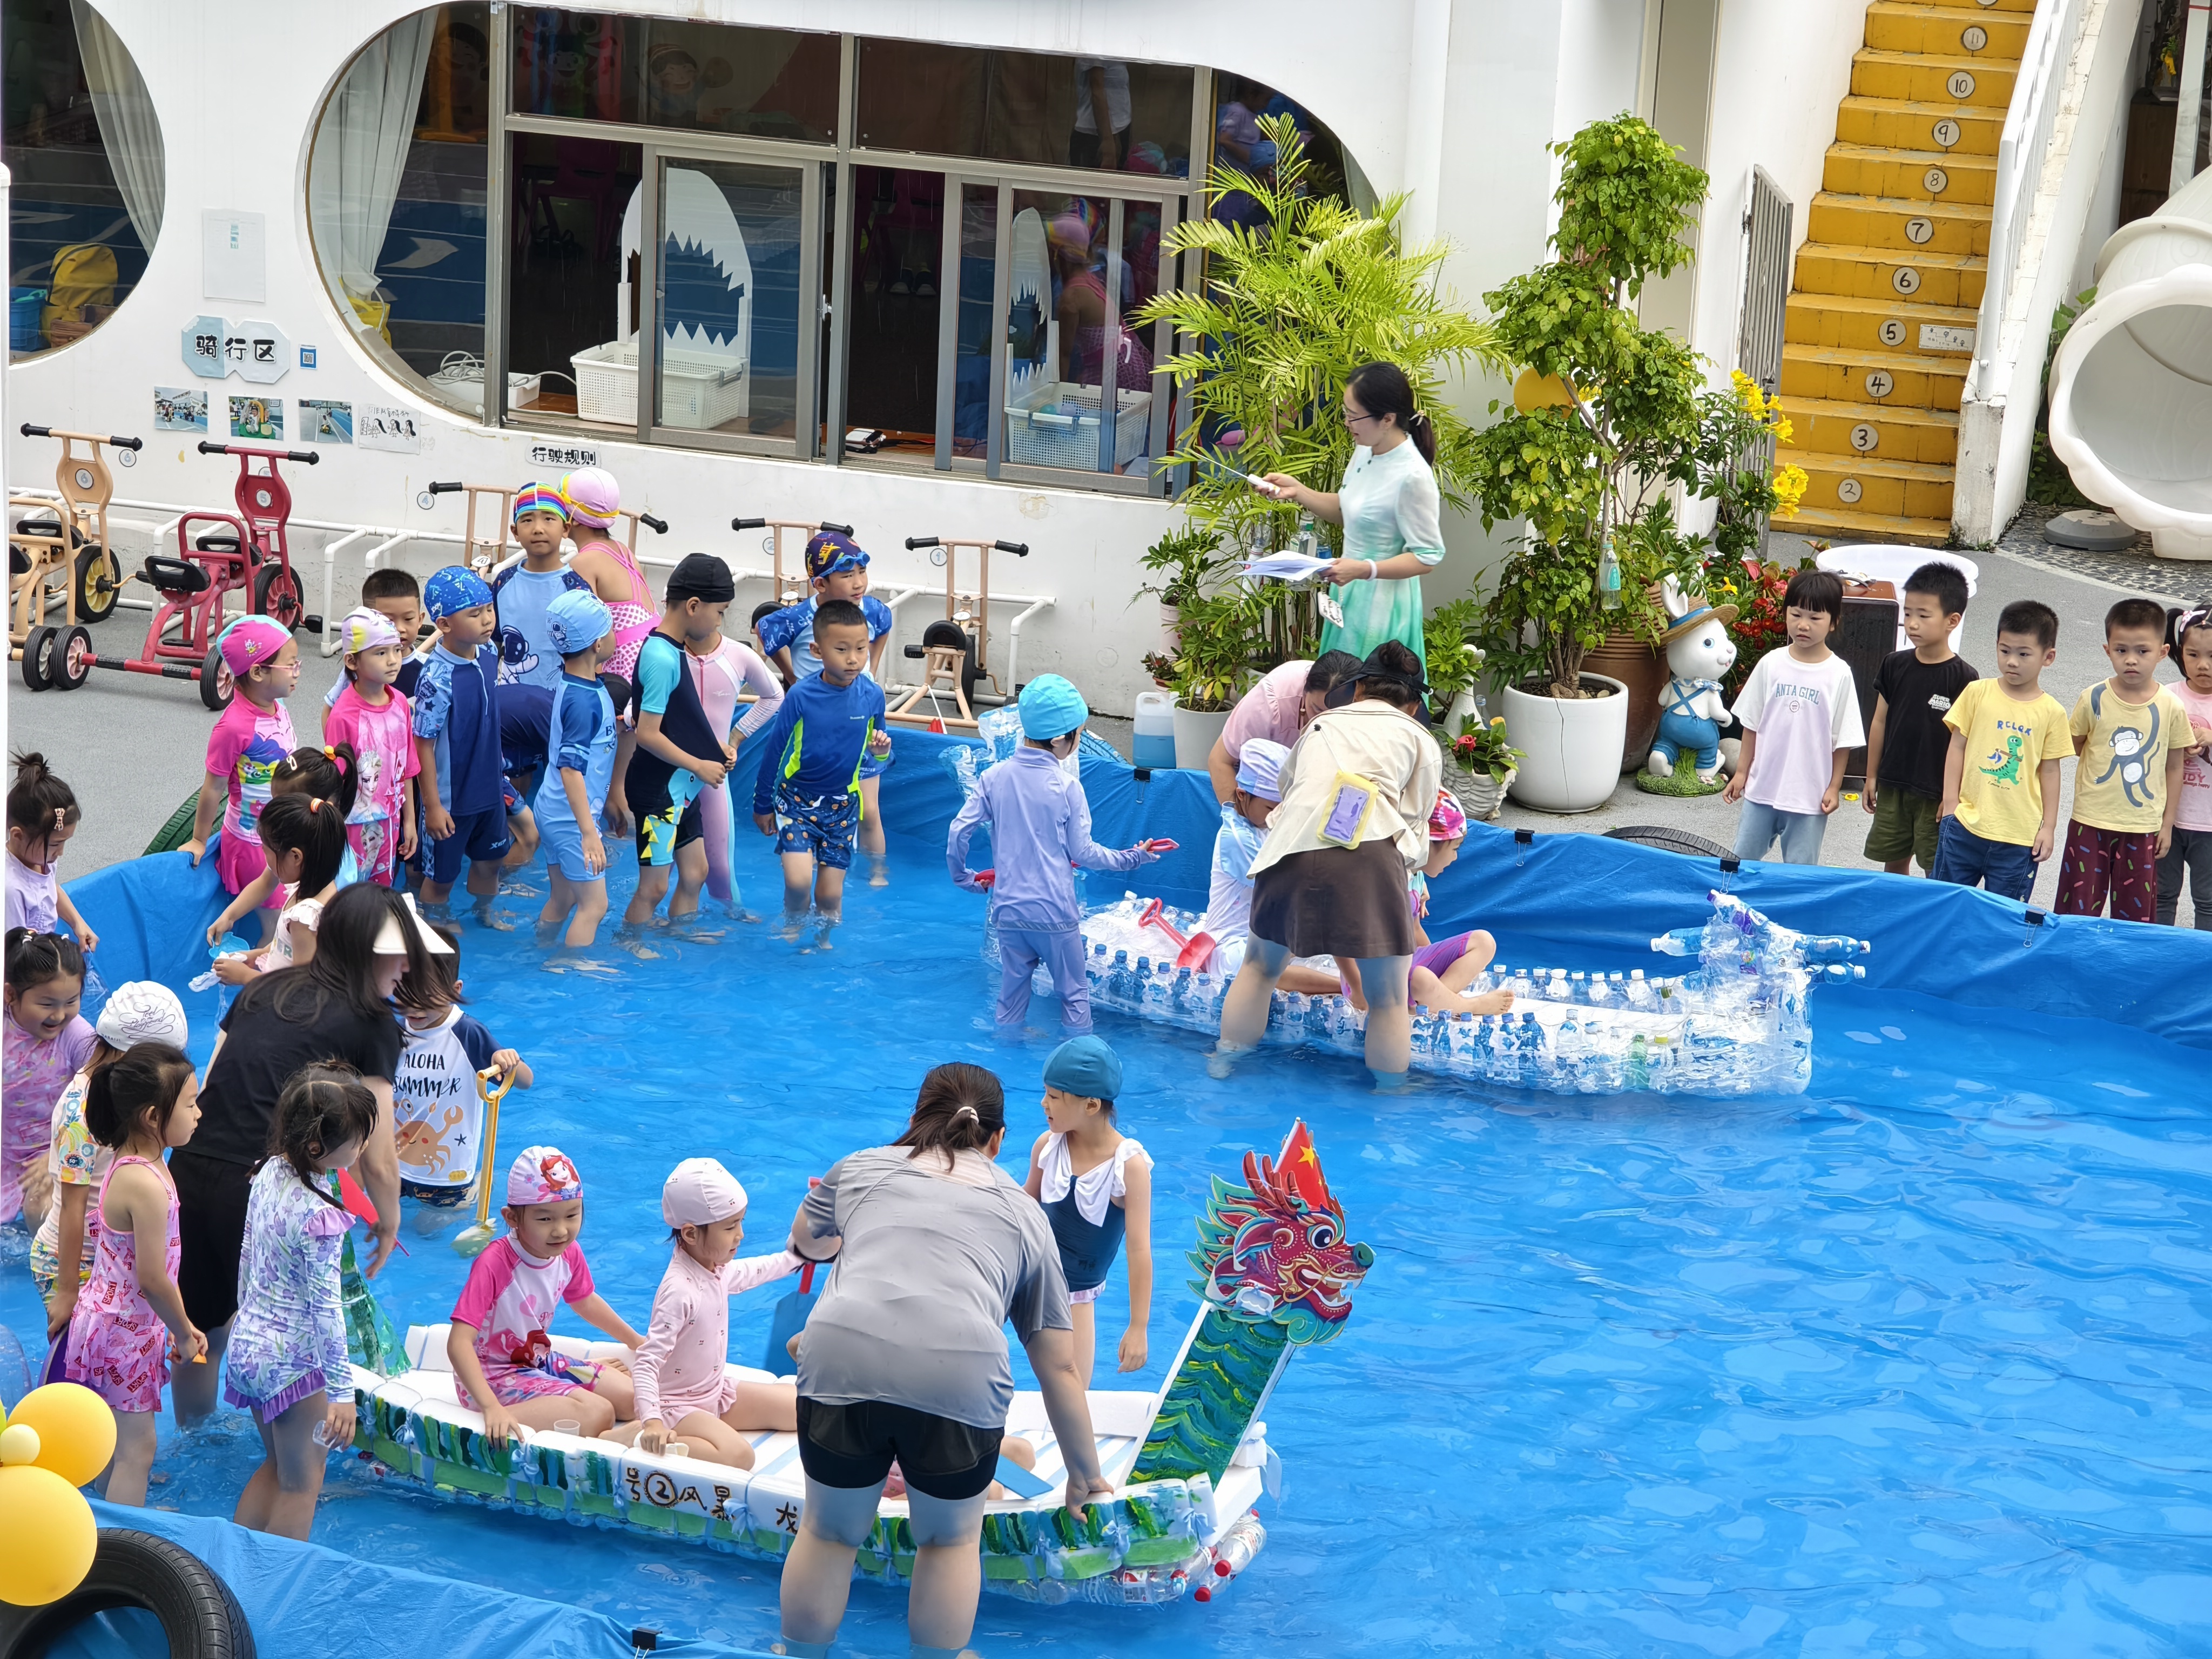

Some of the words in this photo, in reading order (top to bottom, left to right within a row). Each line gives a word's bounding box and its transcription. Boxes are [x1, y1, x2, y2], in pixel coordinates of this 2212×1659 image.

[1955, 79, 1967, 93] 10
[1938, 125, 1948, 142] 9
[1930, 173, 1939, 186] 8
[1912, 222, 1925, 241] 7
[1899, 272, 1912, 288] 6
[1886, 323, 1897, 340] 5
[195, 334, 275, 362] 骑行区
[1871, 376, 1885, 394] 4
[1857, 429, 1868, 447] 3
[124, 453, 131, 463] 6
[532, 447, 596, 466] 行驶规则
[81, 473, 89, 484] 6
[260, 493, 267, 503] 5
[1844, 483, 1856, 496] 2
[421, 495, 429, 505] 4
[1775, 683, 1797, 697] ANTA
[1799, 686, 1819, 705] GIRL
[404, 1053, 445, 1070] ALOHA
[393, 1075, 462, 1098] SUMMER
[103, 1281, 117, 1305] SPORT
[113, 1317, 138, 1332] SPORT
[140, 1336, 156, 1355] SPORT
[127, 1372, 148, 1392] SPORT
